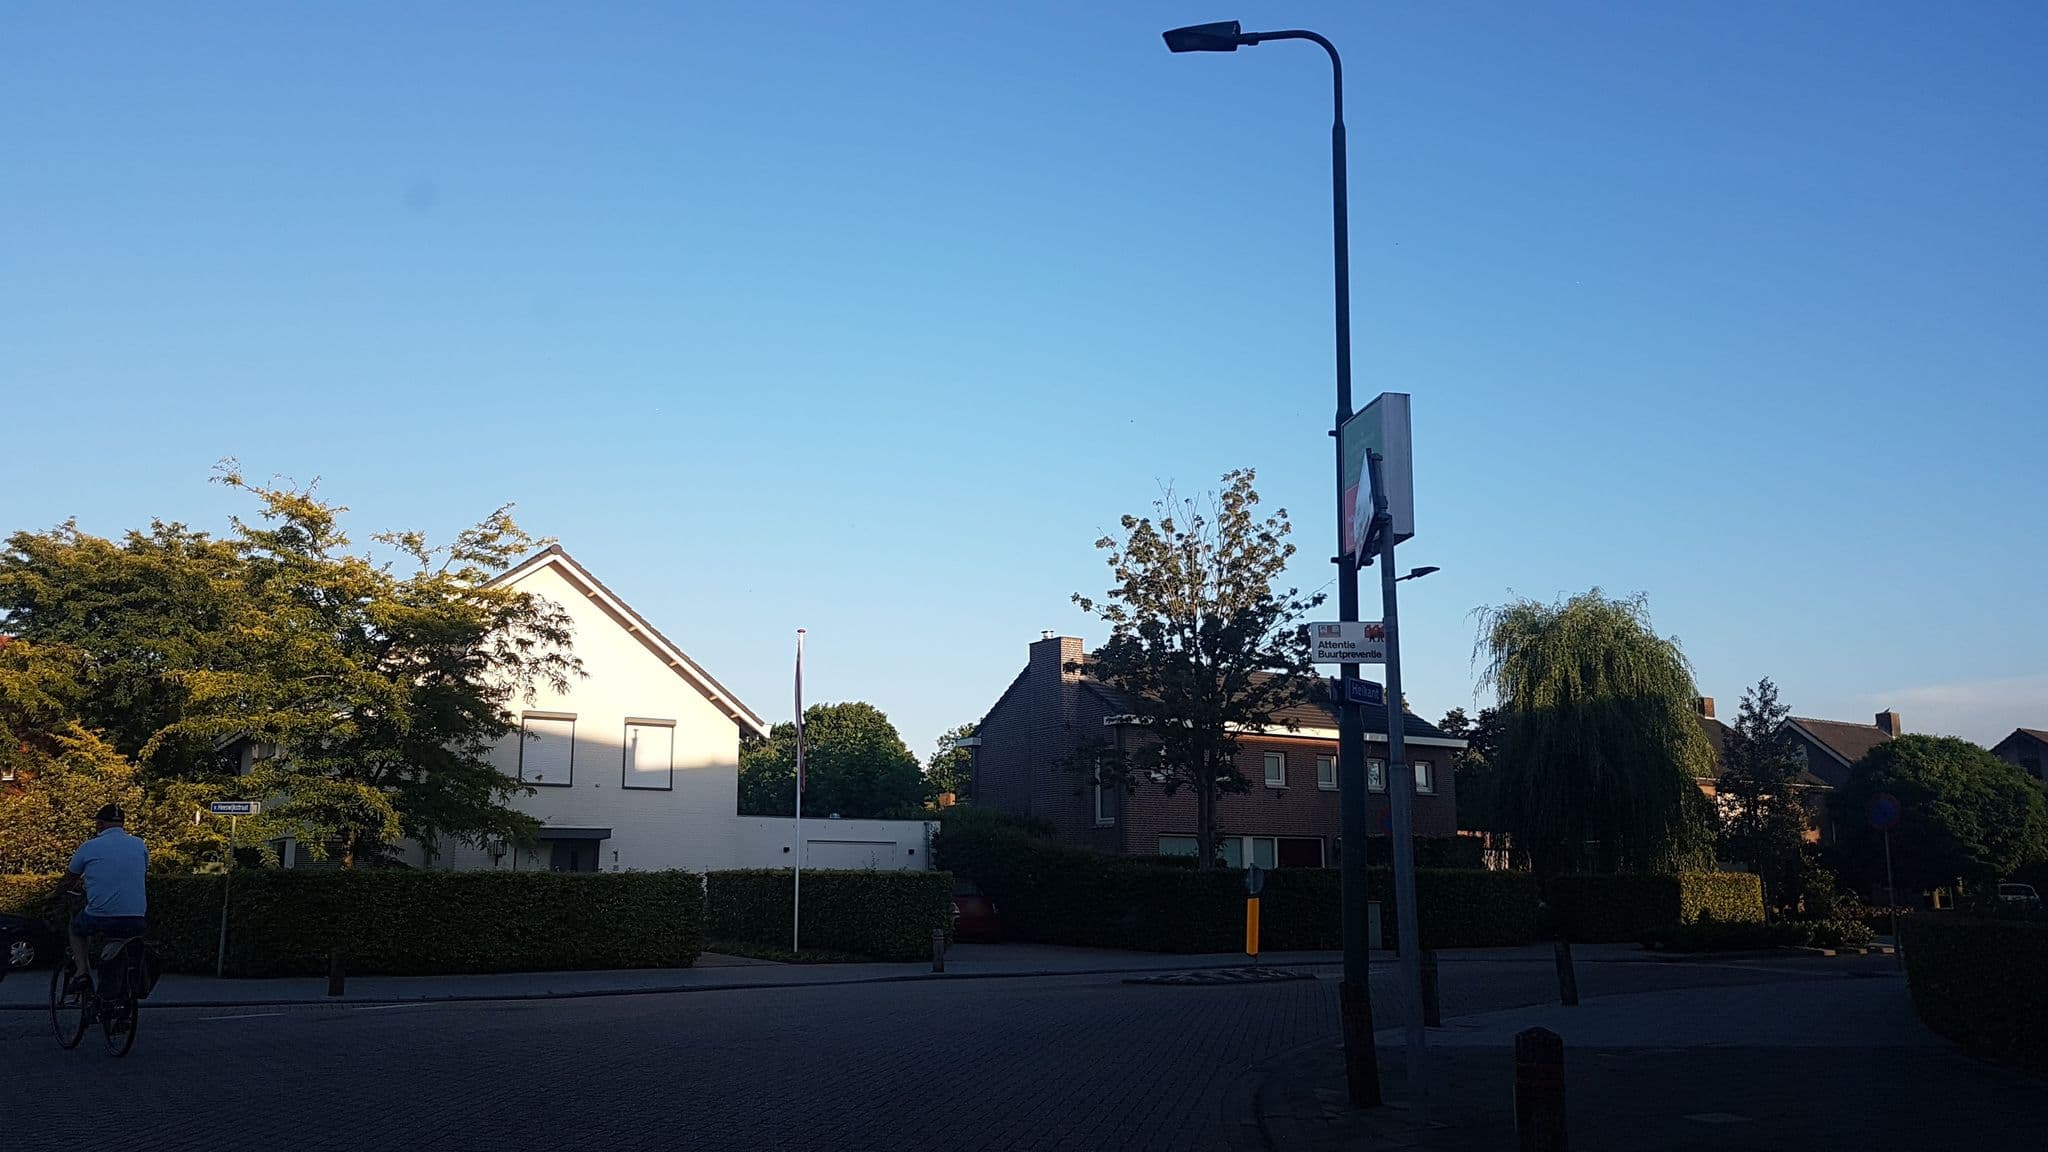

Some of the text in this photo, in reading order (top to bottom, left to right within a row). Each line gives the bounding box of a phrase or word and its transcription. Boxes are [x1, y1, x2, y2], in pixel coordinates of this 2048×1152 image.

[1318, 641, 1356, 649] Attentie
[1318, 650, 1382, 660] Buurtpreventie
[1351, 681, 1380, 700] Heikant
